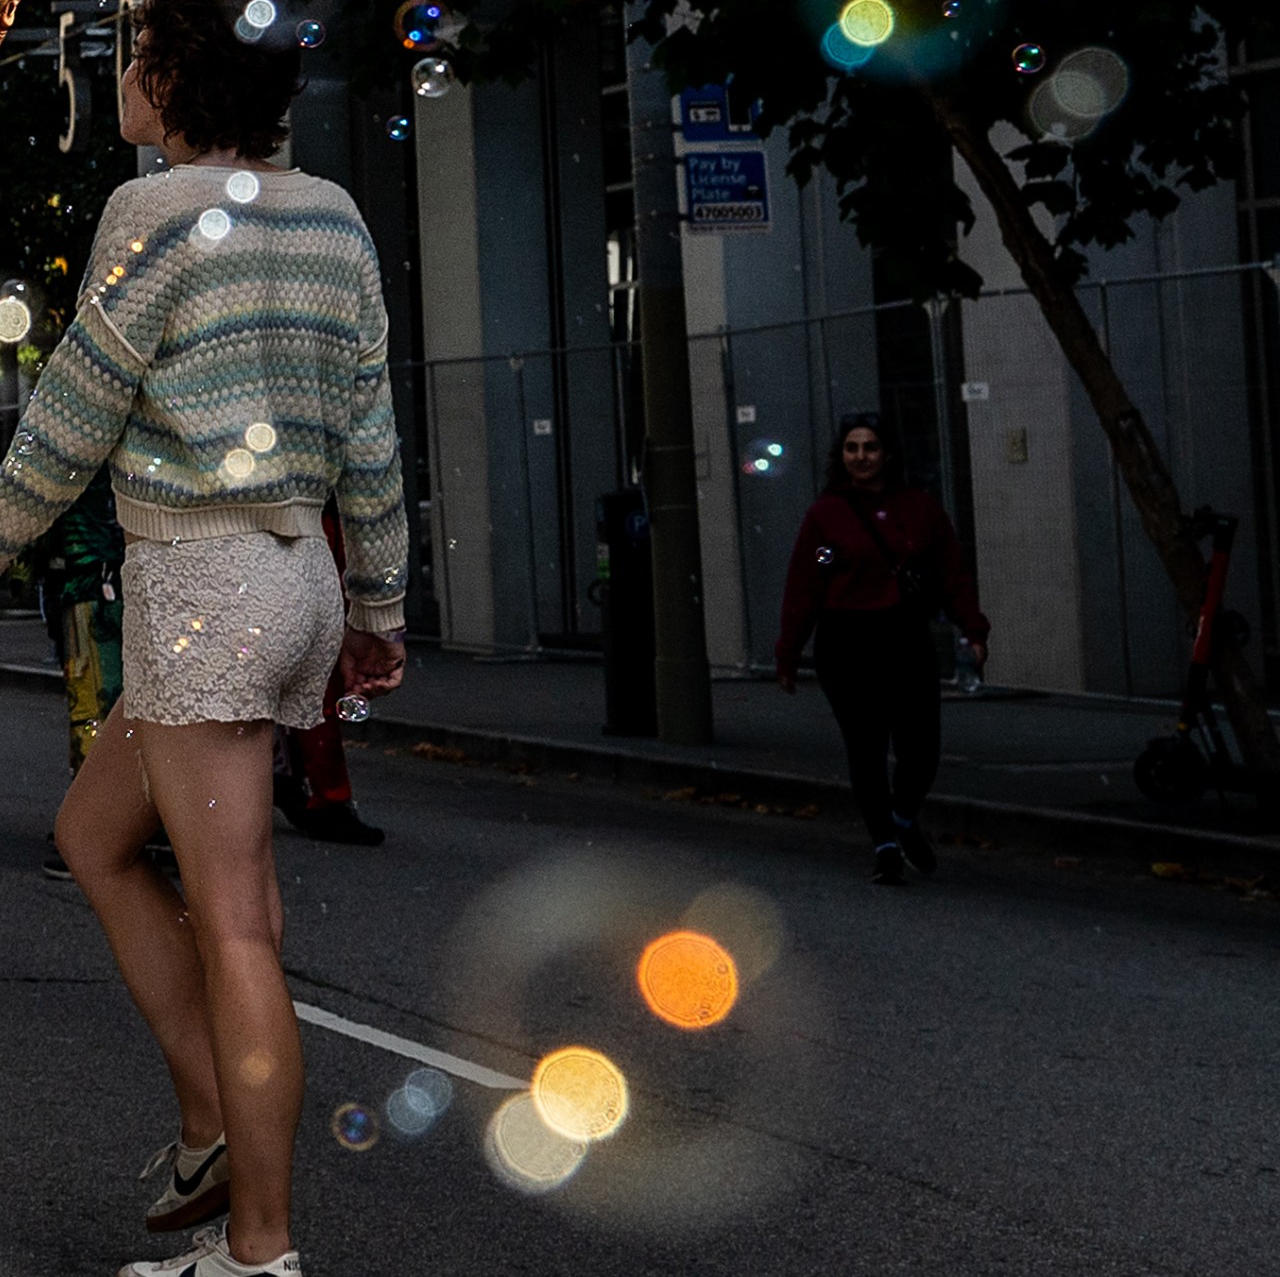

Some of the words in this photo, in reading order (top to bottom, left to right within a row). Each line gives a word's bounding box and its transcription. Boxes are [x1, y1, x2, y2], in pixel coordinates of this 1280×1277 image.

[689, 157, 717, 173] Pay
[721, 156, 741, 173] by
[690, 173, 747, 186] License
[691, 187, 731, 201] Plate
